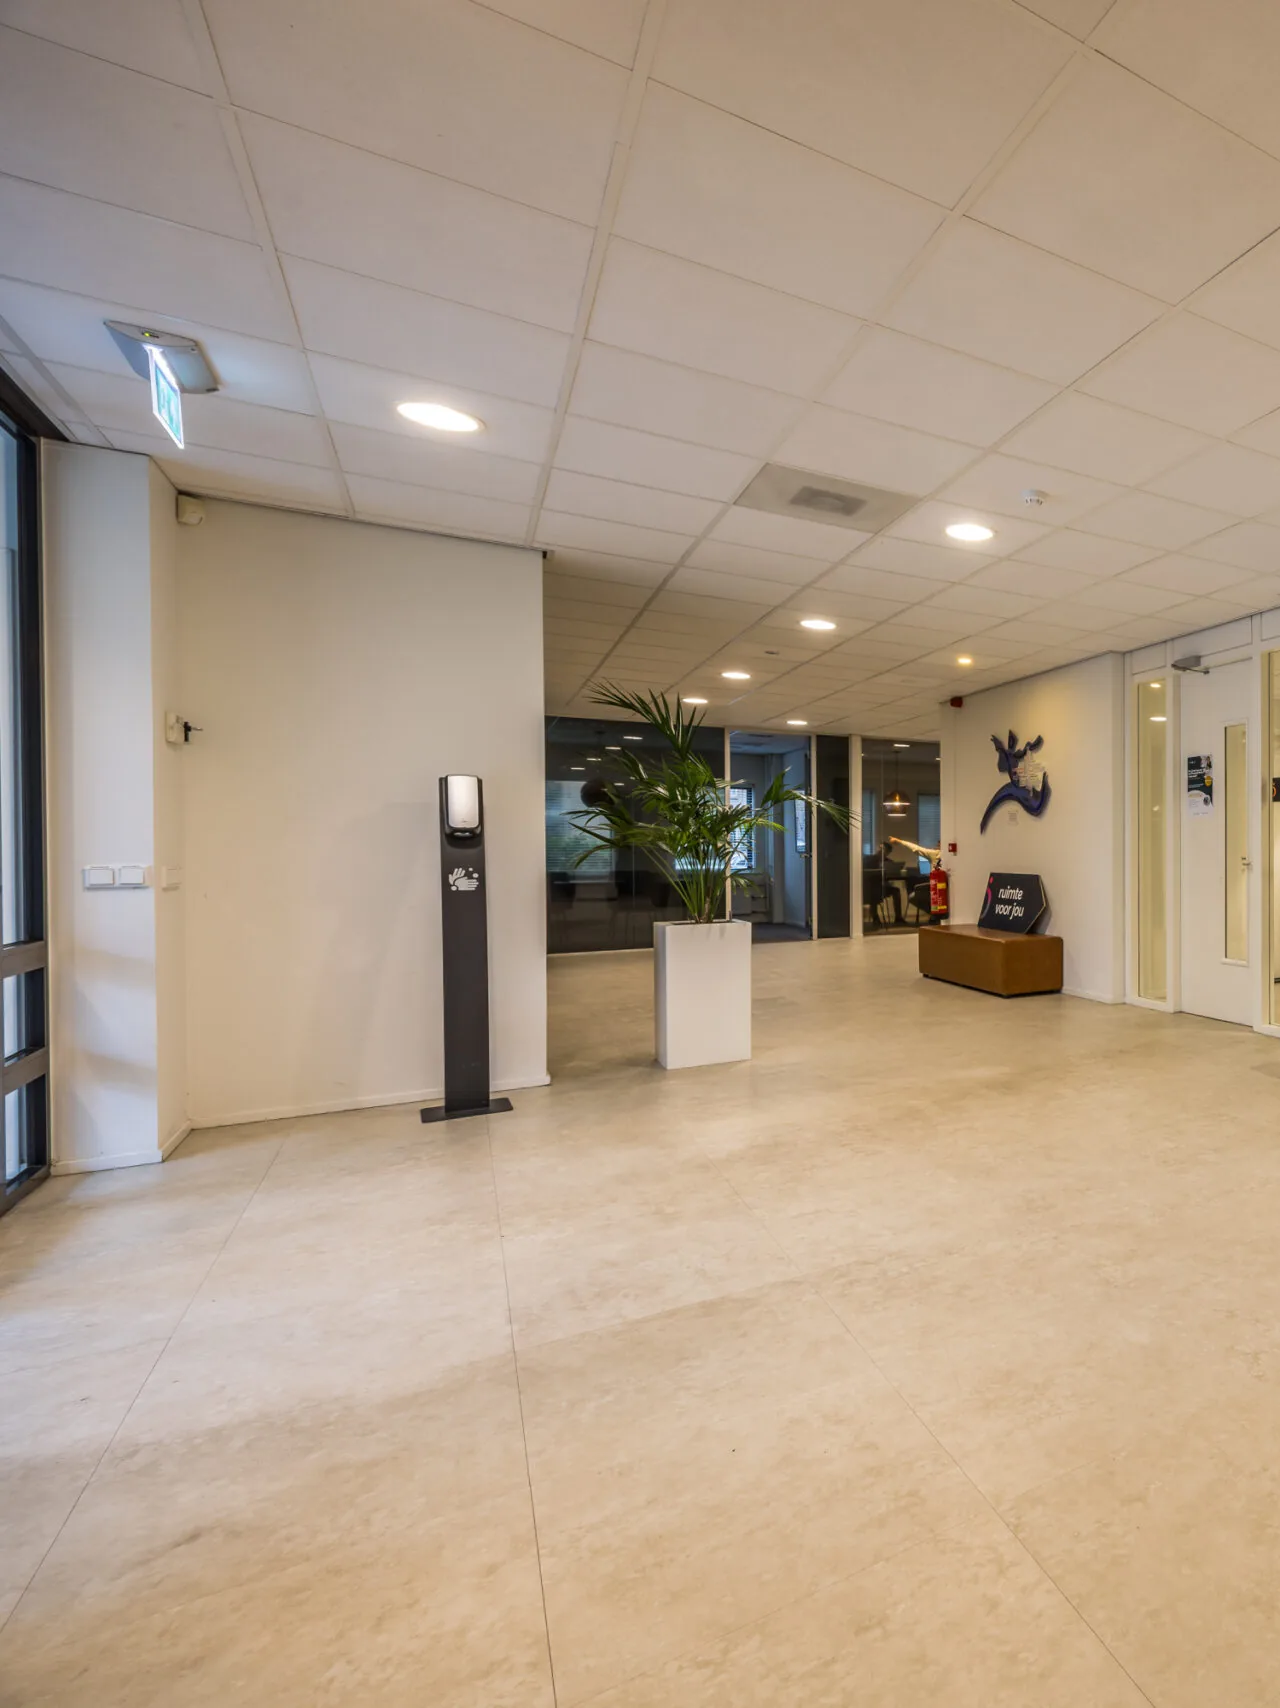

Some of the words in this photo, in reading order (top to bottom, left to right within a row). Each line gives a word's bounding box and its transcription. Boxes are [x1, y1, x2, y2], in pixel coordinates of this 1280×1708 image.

[998, 885, 1023, 900] ruimte
[995, 903, 1012, 915] voor
[1009, 902, 1024, 920] jou
